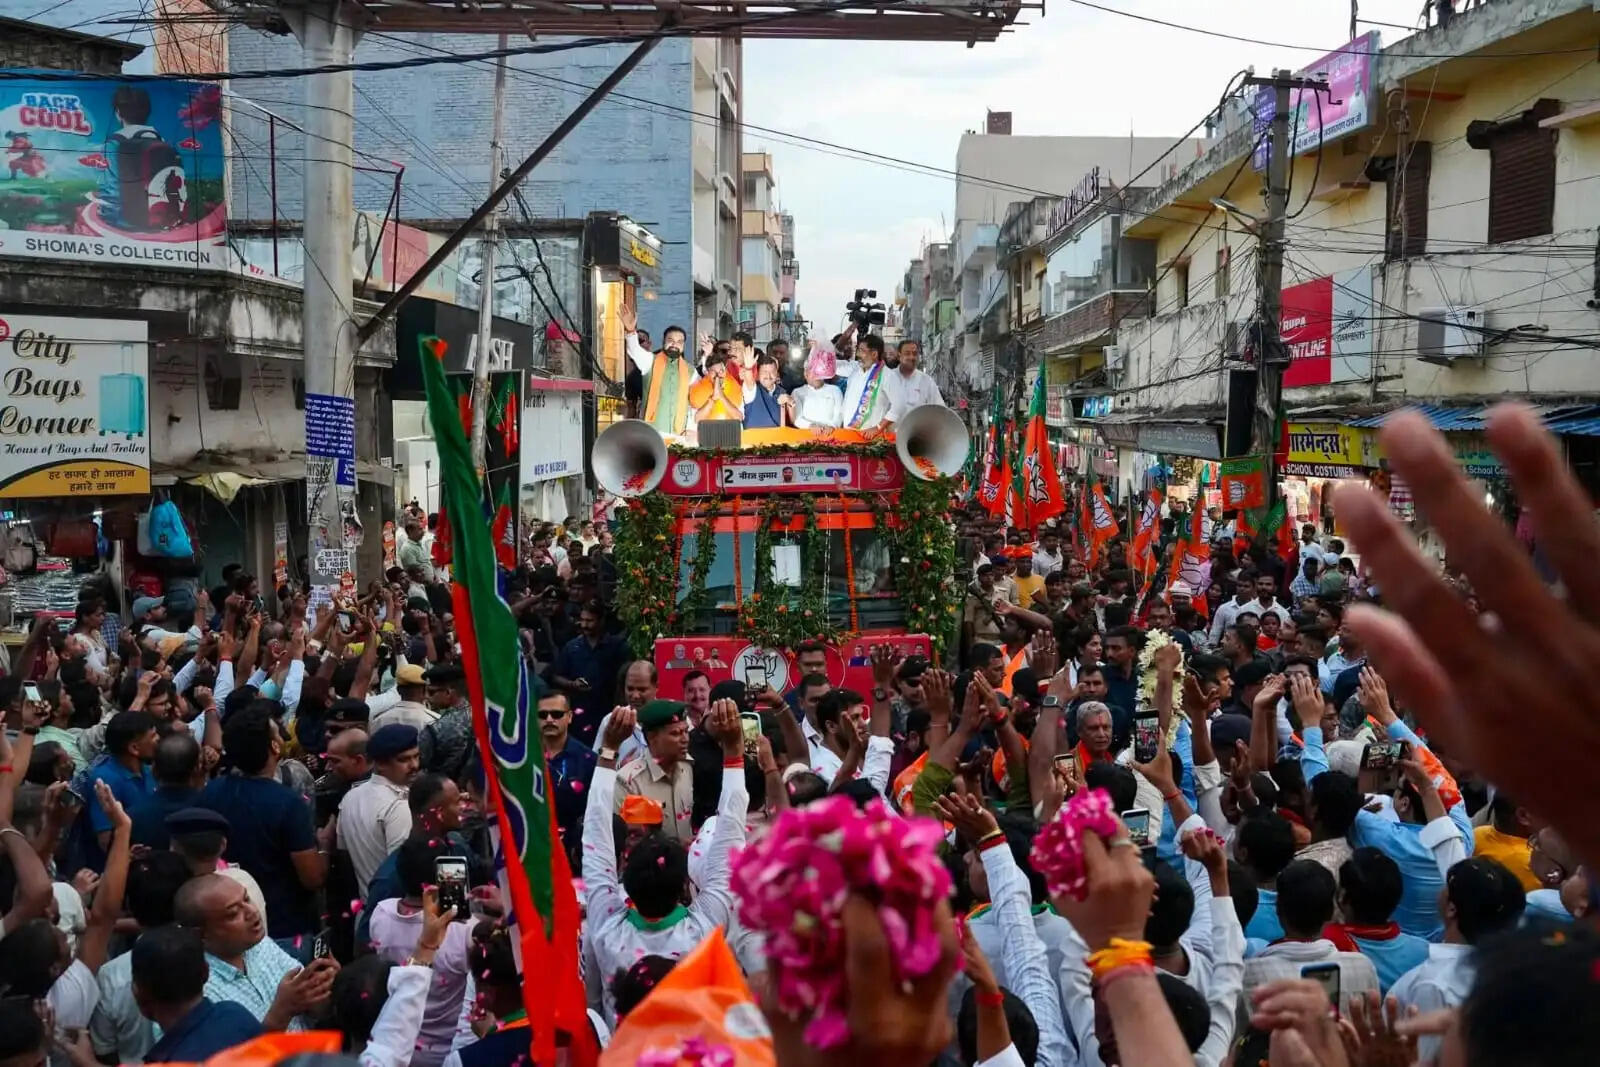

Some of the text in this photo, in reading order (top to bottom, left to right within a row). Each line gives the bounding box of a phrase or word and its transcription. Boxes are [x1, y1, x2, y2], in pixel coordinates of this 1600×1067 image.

[20, 106, 90, 132] COOL
[25, 238, 211, 263] SHOMA'S COLLECTION
[1283, 315, 1307, 332] RUPA
[13, 328, 72, 365] City
[4, 367, 82, 403] Bags
[0, 405, 95, 435] Corner
[5, 443, 146, 455] House of Bags And Trolley
[48, 470, 60, 480] हर
[63, 469, 87, 479] सफर
[104, 469, 136, 478] आसान
[724, 469, 777, 483] 2 नीरज कुमार
[1286, 464, 1314, 475] SCHOOL
[1314, 465, 1354, 477] COSTUMES
[1468, 465, 1493, 475] School
[70, 480, 93, 492] हमारे
